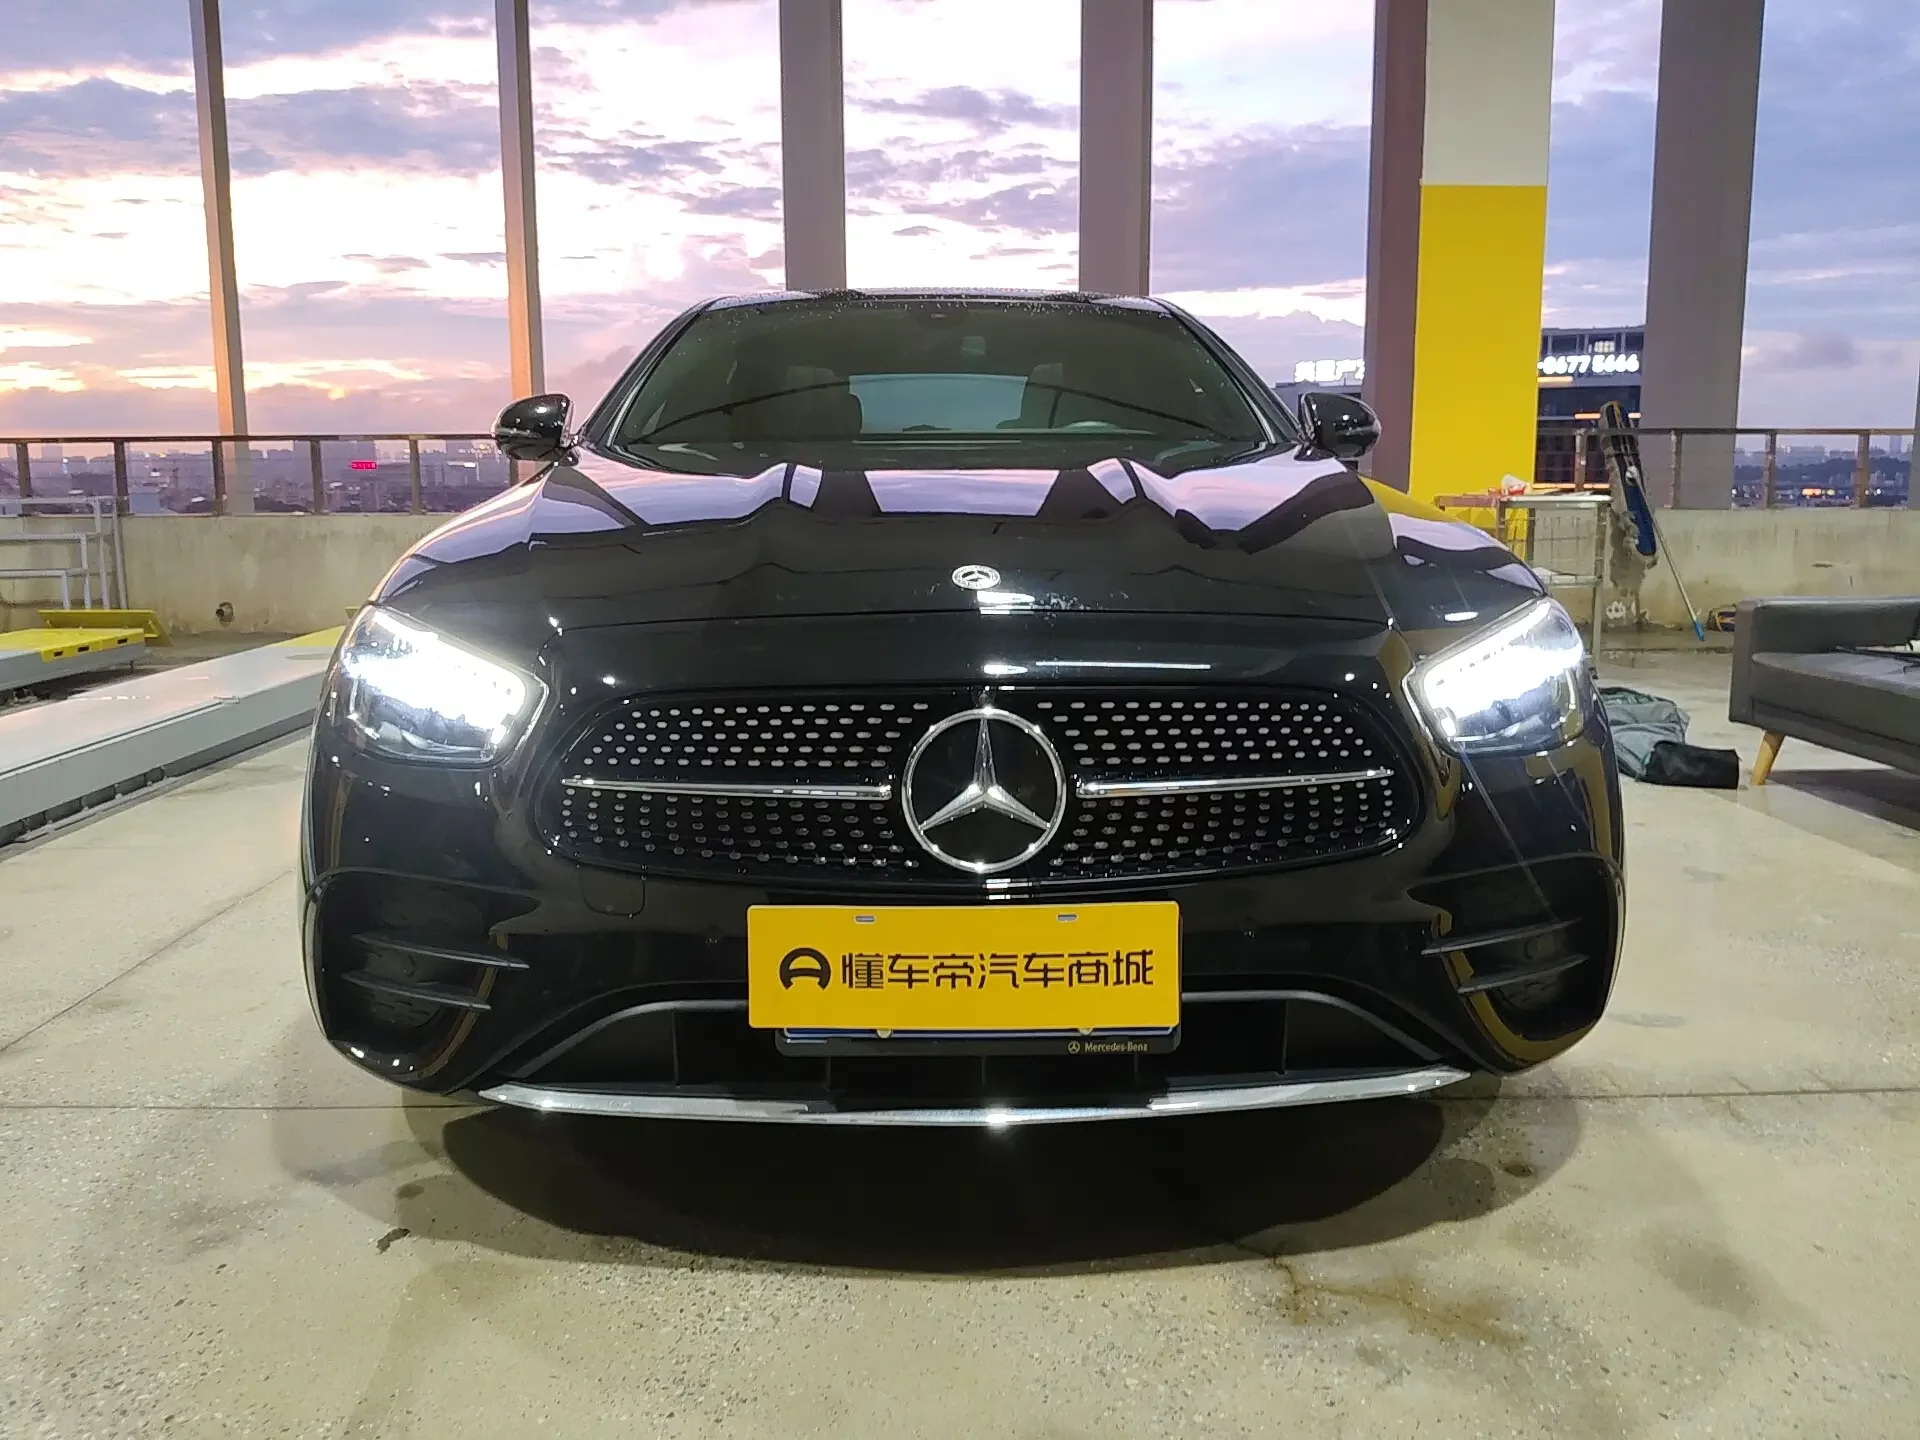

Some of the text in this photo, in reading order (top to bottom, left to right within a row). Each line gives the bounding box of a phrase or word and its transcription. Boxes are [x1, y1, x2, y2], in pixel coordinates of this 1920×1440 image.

[841, 949, 1154, 989] 懂车帝汽车商城
